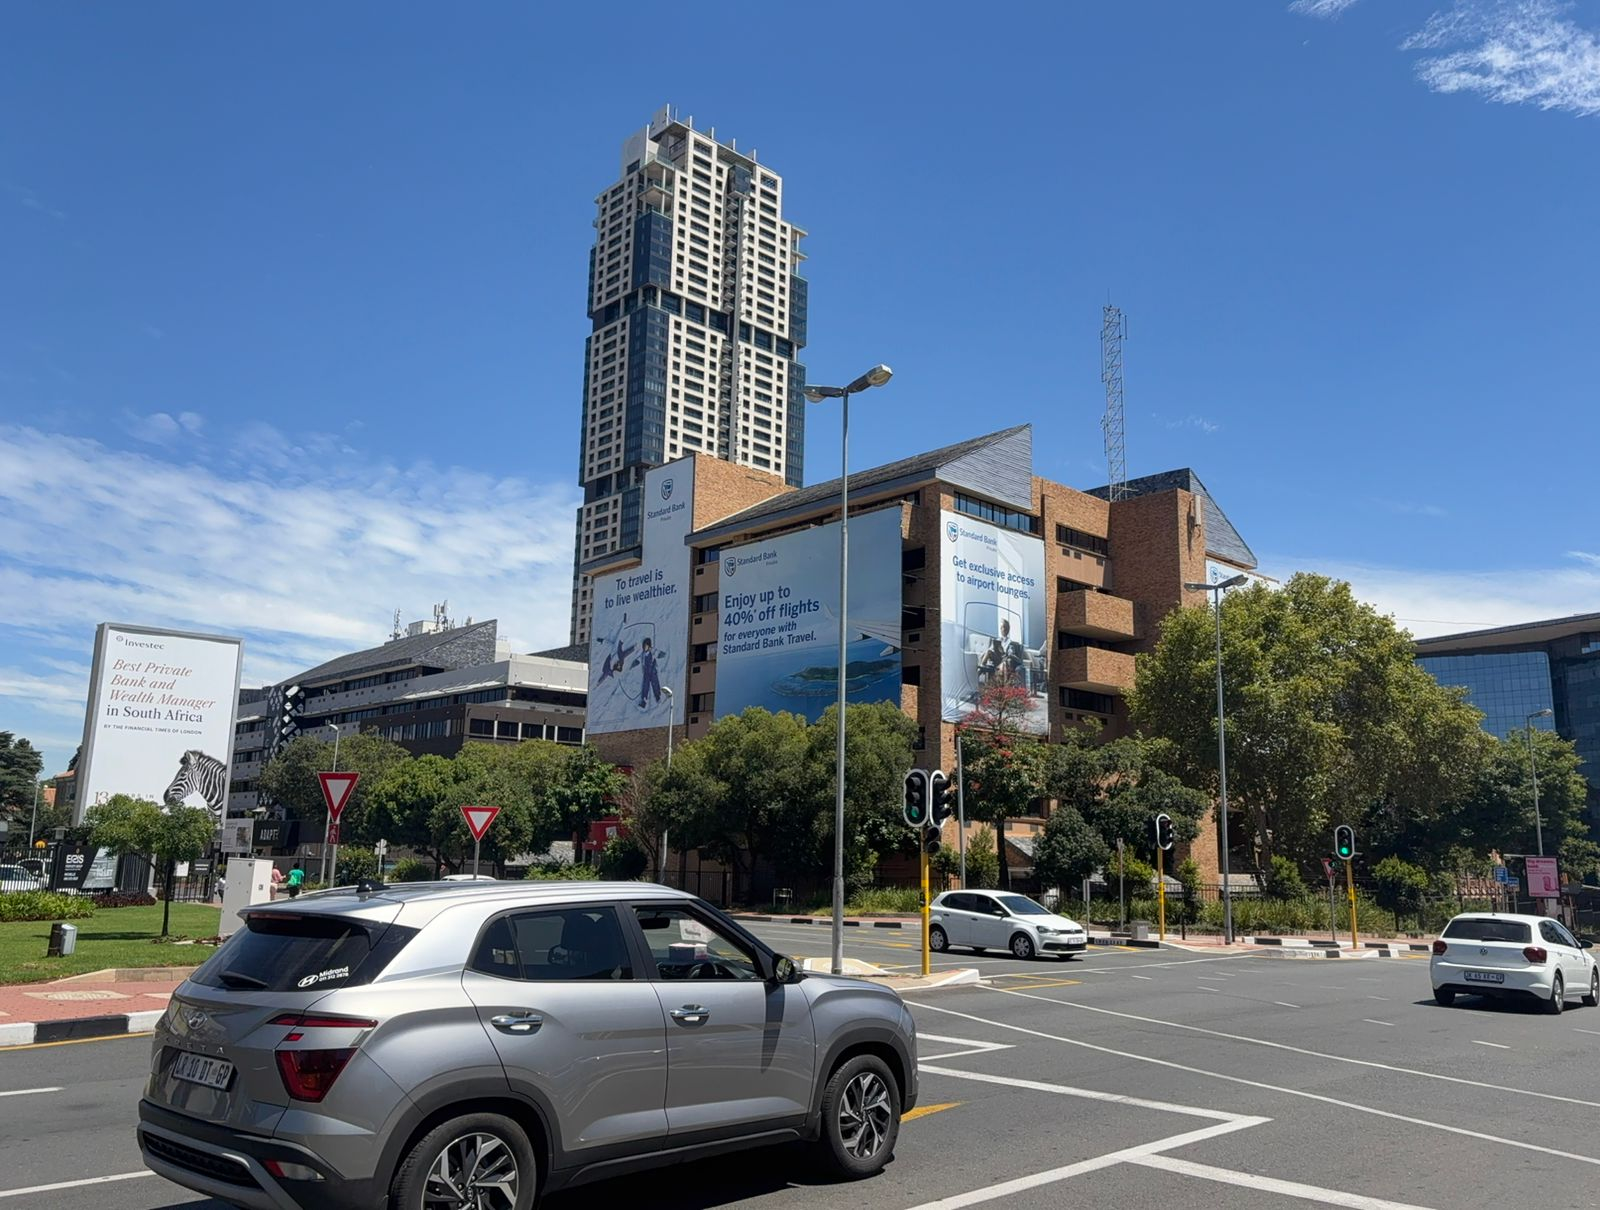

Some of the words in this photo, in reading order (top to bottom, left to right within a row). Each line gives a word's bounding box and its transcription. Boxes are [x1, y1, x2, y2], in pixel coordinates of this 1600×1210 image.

[648, 506, 671, 519] Standard
[672, 502, 685, 512] Bank
[960, 528, 983, 542] Standard
[984, 536, 997, 546] Bank
[737, 552, 762, 566] Standard
[763, 550, 777, 560] Bank
[616, 578, 626, 591] To
[628, 570, 652, 588] travel
[655, 569, 663, 580] is
[953, 555, 967, 569] Get
[969, 562, 1005, 579] exclusive
[1007, 572, 1035, 586] access
[957, 571, 965, 582] to
[967, 575, 994, 591] airport
[997, 582, 1031, 599] lounges.
[605, 597, 614, 609] to
[616, 594, 631, 606] live
[633, 584, 677, 601] wealthier.
[725, 593, 756, 610] Enjoy
[760, 590, 774, 605] up
[778, 586, 790, 599] to
[759, 605, 776, 621] off
[779, 599, 820, 619] flights
[724, 632, 735, 642] for
[738, 626, 776, 640] everyone
[779, 621, 796, 633] with
[125, 639, 164, 650] Investec
[723, 641, 760, 654] Standard
[763, 636, 784, 648] Bank
[787, 631, 816, 645] Travel.
[113, 658, 142, 672] Best
[144, 662, 192, 677] Private
[111, 674, 147, 687] Bank
[149, 679, 176, 690] and
[110, 689, 154, 704] Wealth
[158, 694, 216, 710] Manager
[106, 704, 118, 716] in
[123, 706, 160, 720] South
[164, 710, 203, 722] Africa
[319, 966, 349, 977] Midrand
[215, 1064, 230, 1085] GP
